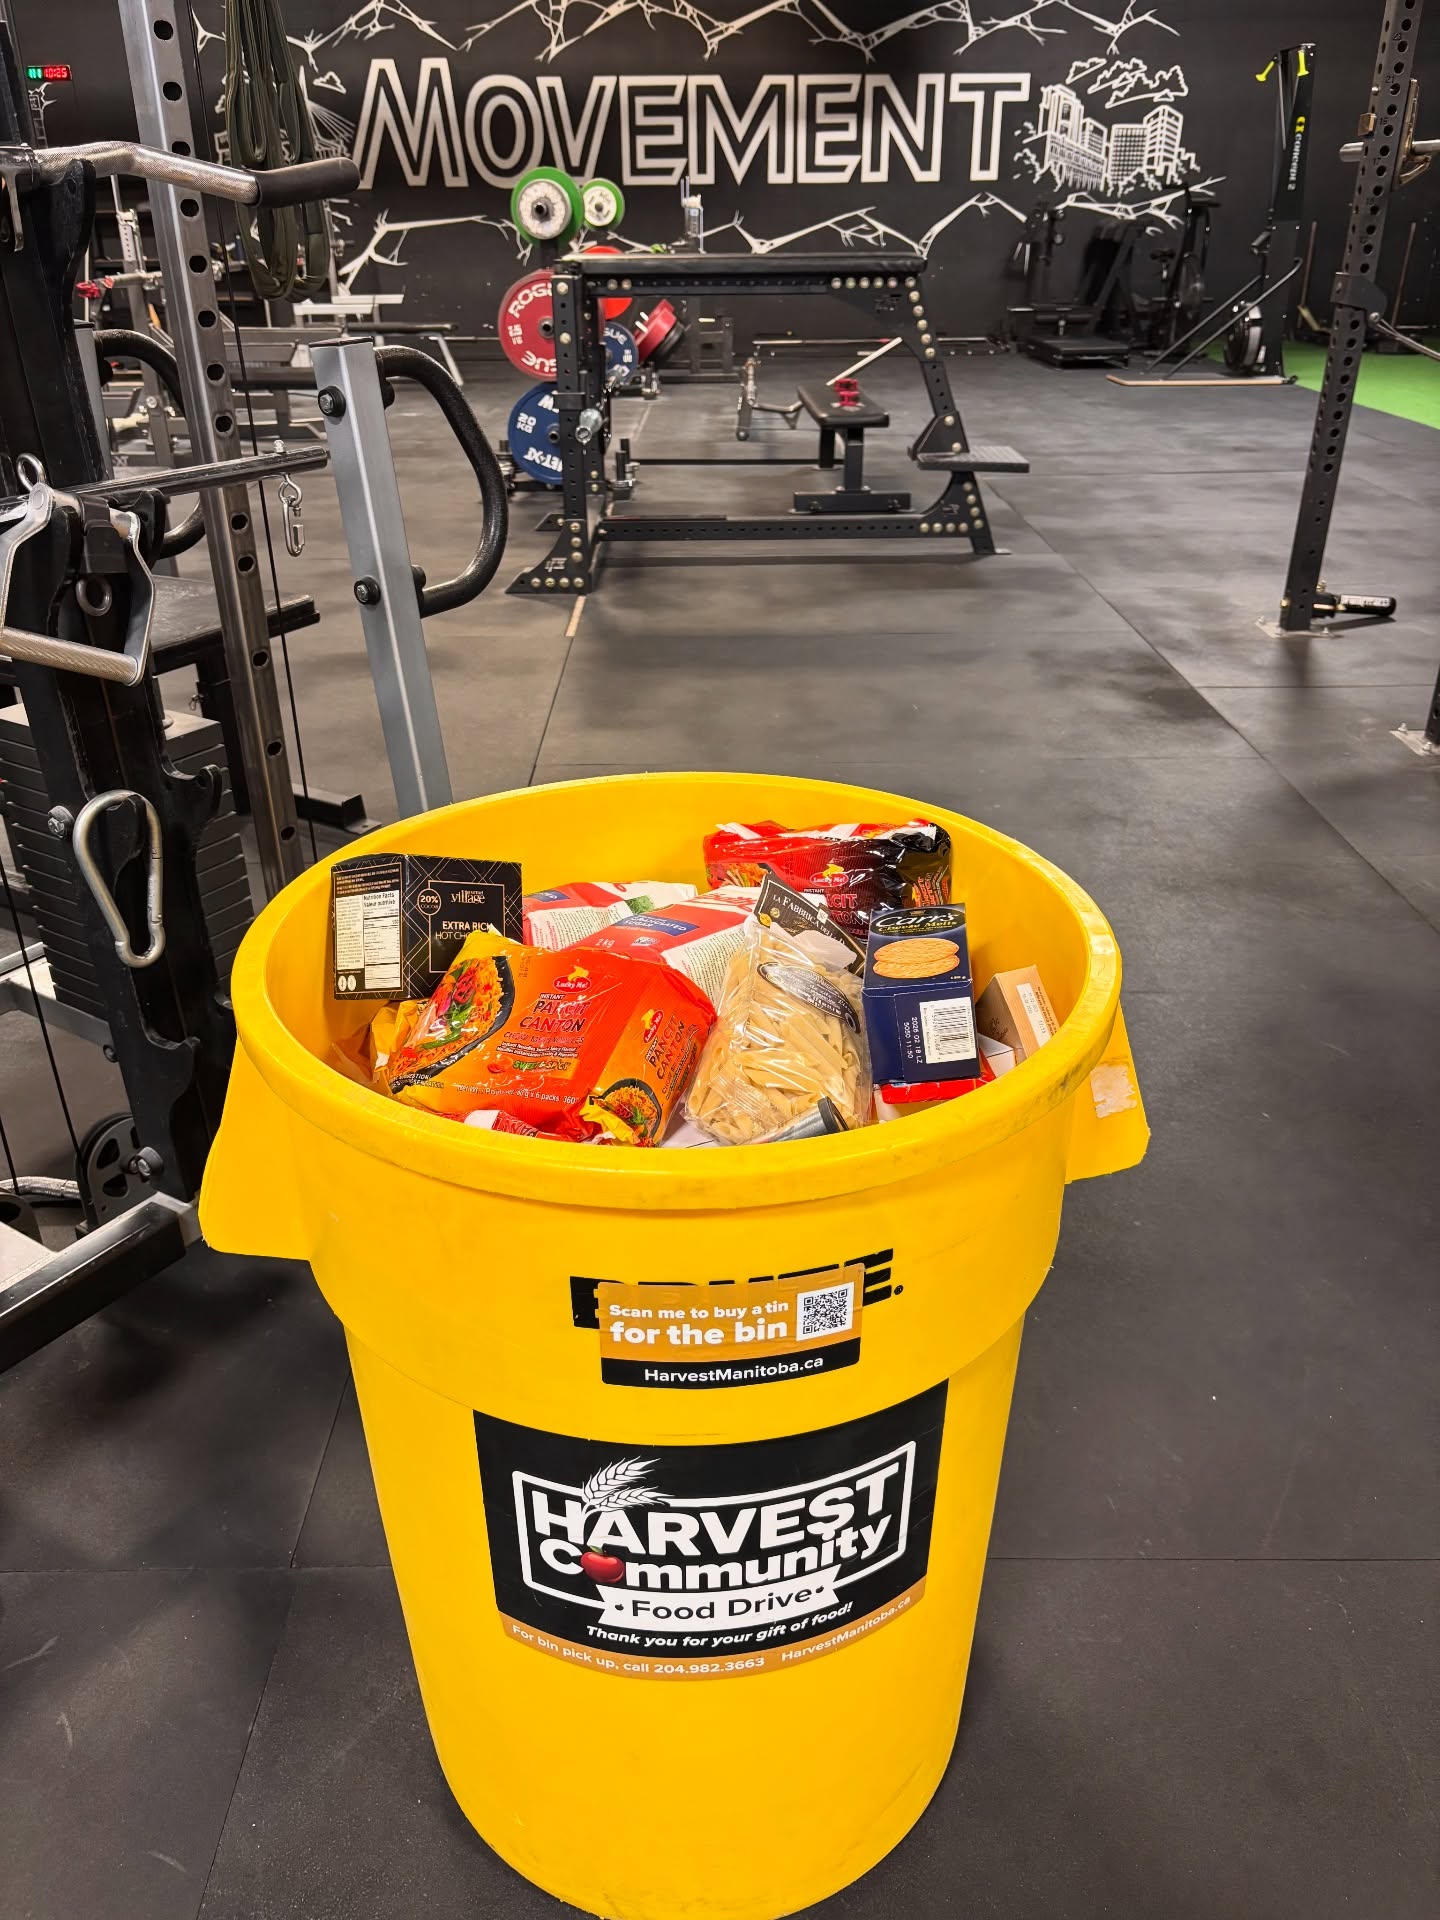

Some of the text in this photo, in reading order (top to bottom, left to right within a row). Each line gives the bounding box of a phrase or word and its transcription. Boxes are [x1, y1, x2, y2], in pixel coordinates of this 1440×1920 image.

[508, 282, 552, 318] ROG
[517, 412, 536, 425] 20
[516, 421, 533, 434] KG
[420, 895, 439, 904] 20%
[773, 895, 781, 903] LA
[827, 893, 858, 908] CIT
[442, 920, 470, 930] EXTRA
[831, 910, 864, 926] TON
[875, 911, 959, 928] Carr's
[435, 932, 453, 940] HOT
[595, 938, 615, 948] 2 kg
[555, 980, 588, 989] Lucky Me!
[533, 1000, 590, 1016] PANCIT
[519, 1017, 586, 1033] CANTON
[911, 1016, 919, 1034] 2026
[649, 1014, 678, 1067] PANCIT
[914, 1034, 921, 1044] 02
[656, 1020, 685, 1080] CANTON
[541, 1093, 560, 1101] packs
[608, 1300, 789, 1321] Scan me to buy a tin
[608, 1318, 788, 1345] for the bin
[643, 1356, 824, 1383] HarvestManitoba.ca
[531, 1460, 900, 1556] HARVEST
[631, 1585, 813, 1620] Food Drive
[586, 1601, 854, 1648] Thank you for your gift of food!
[780, 1595, 912, 1663] HarvestManitoba.ca
[512, 1624, 766, 1676] For bin pick up, call 204.982.3663
